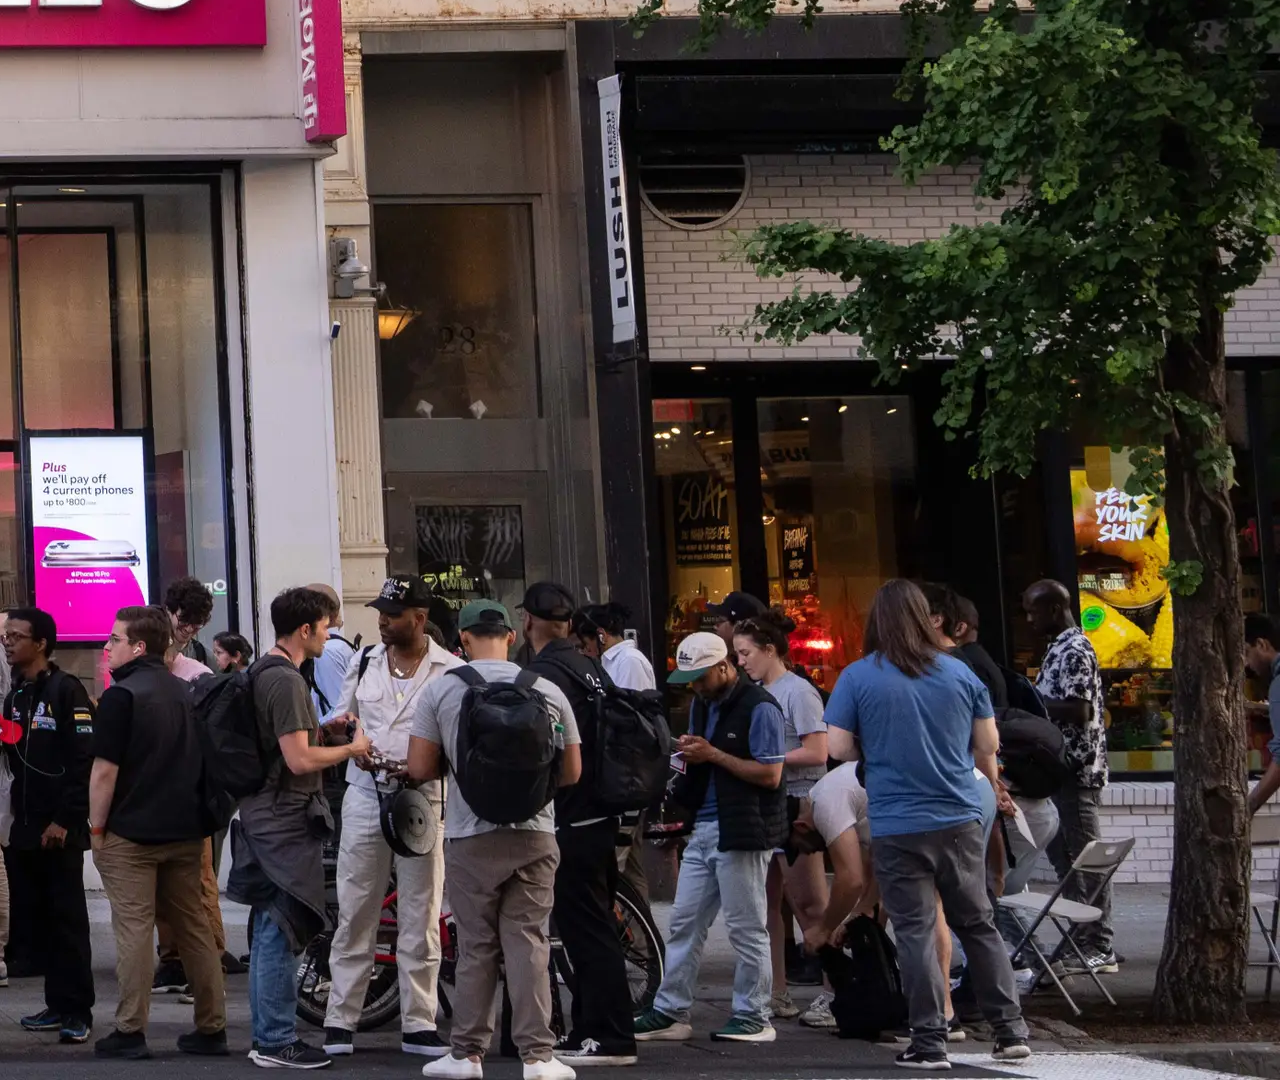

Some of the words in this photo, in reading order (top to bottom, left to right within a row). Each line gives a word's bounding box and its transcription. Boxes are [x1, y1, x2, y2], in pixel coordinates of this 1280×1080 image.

[605, 110, 614, 169] FRESH
[609, 175, 630, 309] LUSH
[42, 461, 67, 473] Plus
[42, 474, 67, 484] we'll
[70, 476, 89, 486] pay
[91, 473, 107, 484] off
[42, 485, 50, 495] 4
[52, 486, 92, 495] current
[94, 485, 134, 497] phones
[43, 499, 54, 507] up
[1095, 504, 1148, 525] YOUR
[1097, 521, 1145, 542] SKIN
